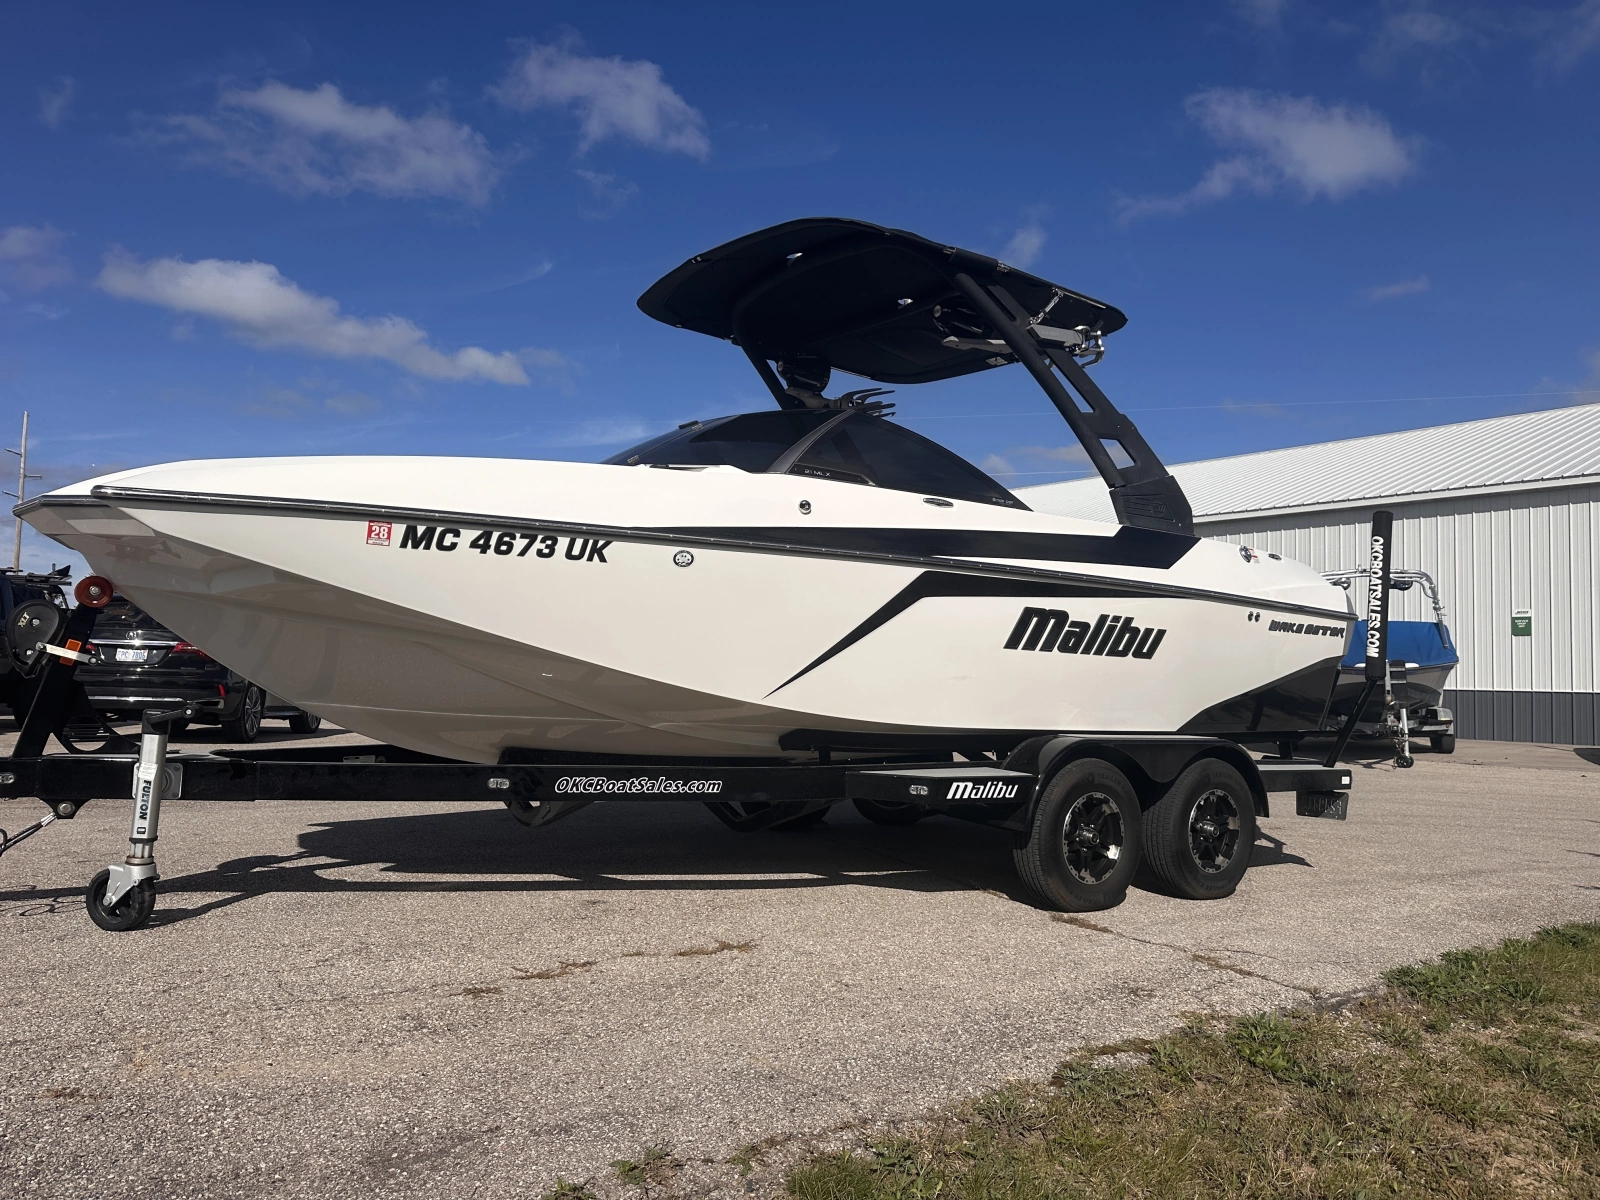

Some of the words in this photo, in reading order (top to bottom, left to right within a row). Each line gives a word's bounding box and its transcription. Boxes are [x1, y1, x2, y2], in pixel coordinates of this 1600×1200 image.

[370, 525, 389, 539] 28
[399, 524, 461, 552] MC
[468, 530, 559, 559] 4673
[564, 537, 614, 563] UK
[1366, 535, 1384, 658] OKCBOATSALES.COM
[17, 611, 30, 628] XLT
[1003, 606, 1167, 660] Malibu
[554, 776, 723, 793] OKCBoatSales.com
[945, 781, 1019, 800] Malibu
[138, 779, 152, 820] FULTON
